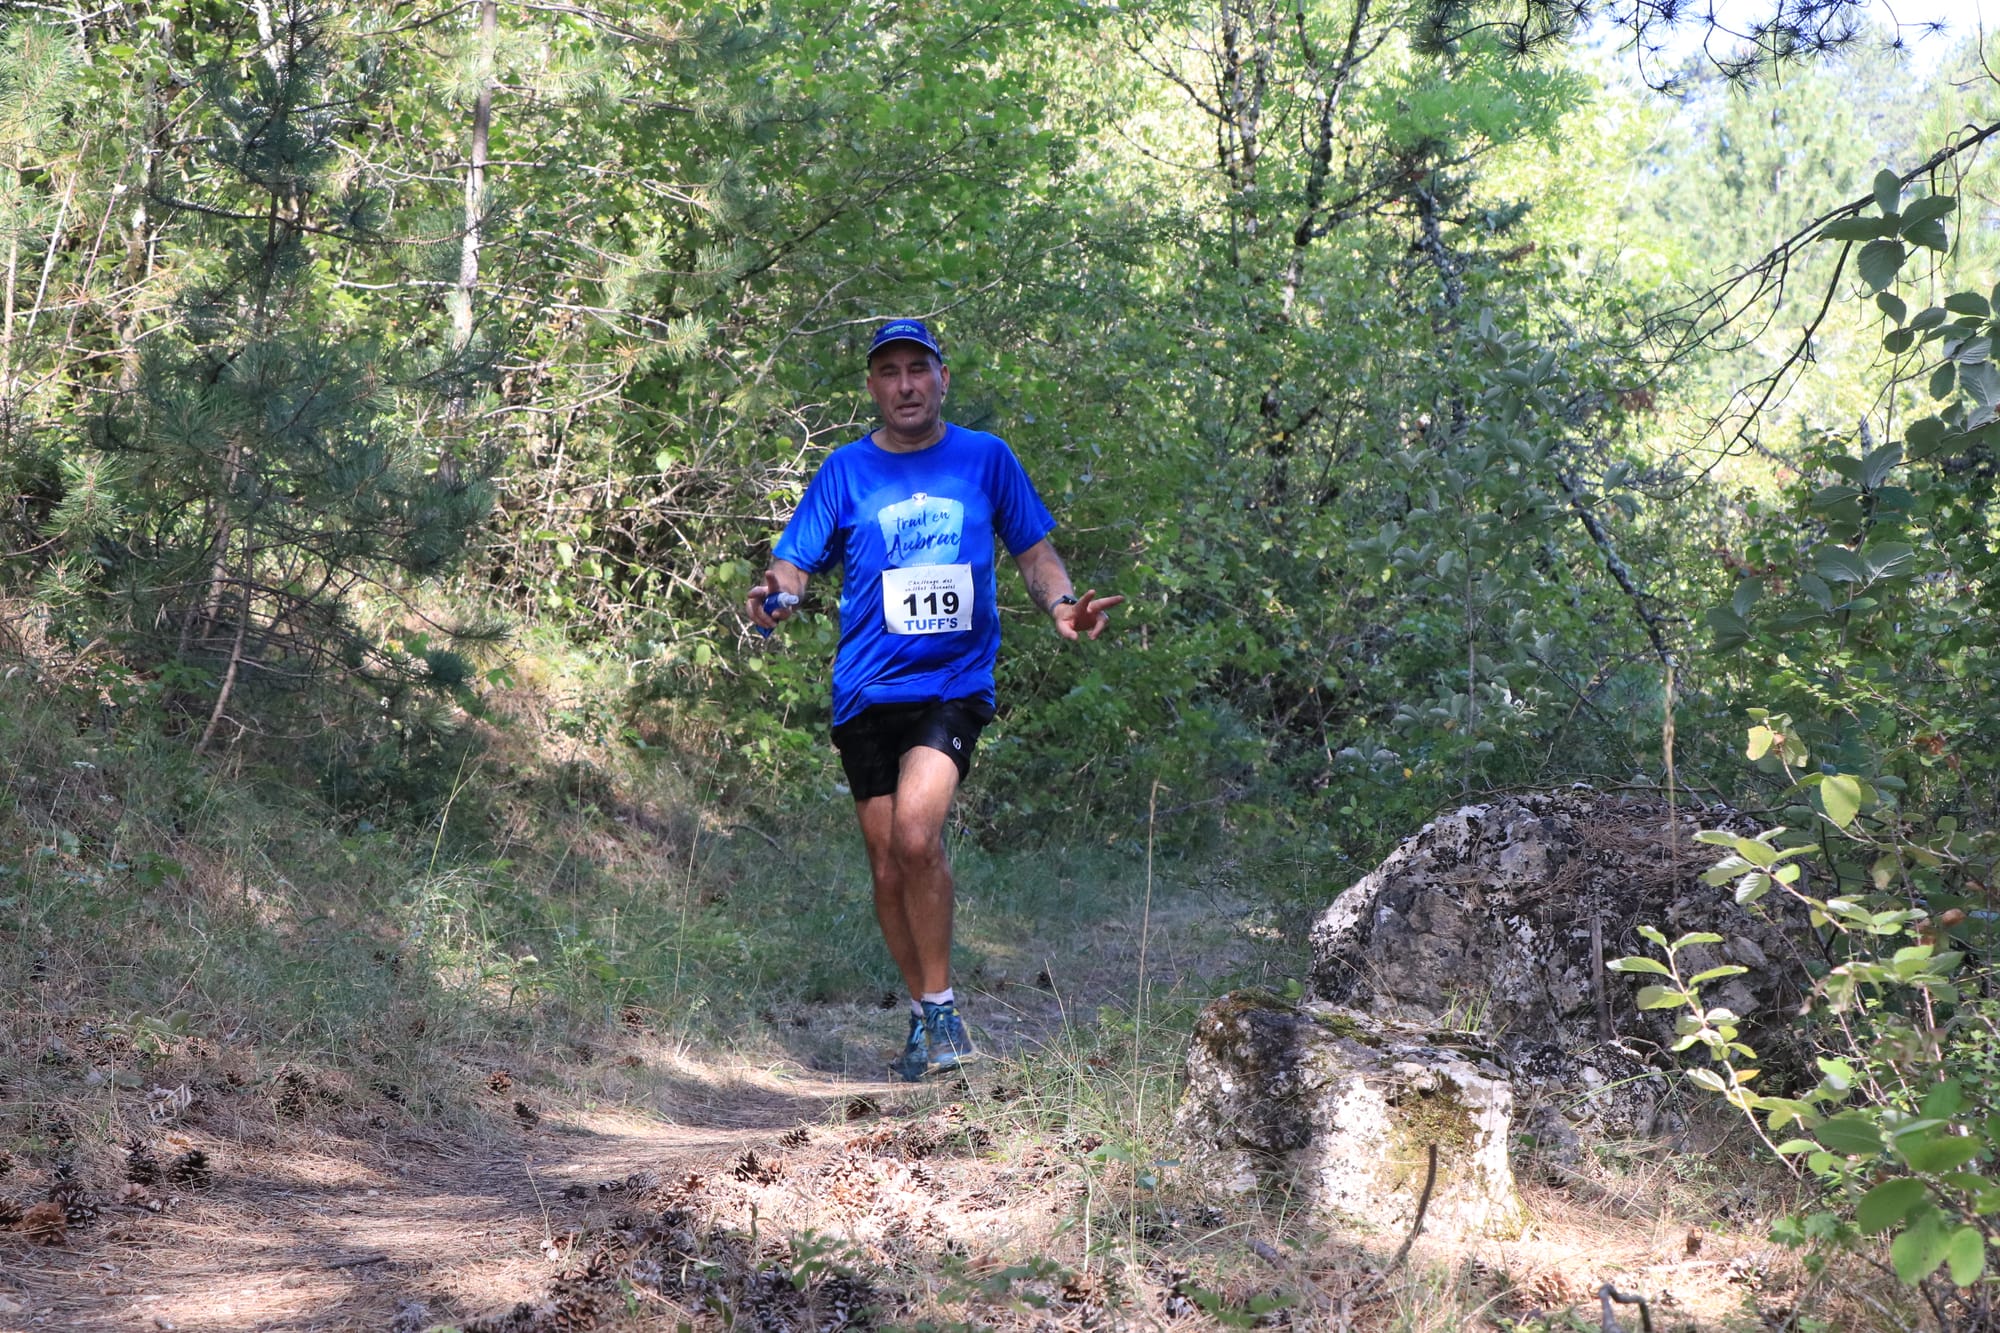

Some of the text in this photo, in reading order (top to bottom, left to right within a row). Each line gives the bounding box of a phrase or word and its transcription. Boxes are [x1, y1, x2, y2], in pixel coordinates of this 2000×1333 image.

[932, 511, 950, 522] en
[886, 531, 961, 560] Aubrac
[903, 591, 960, 617] 119
[904, 617, 958, 631] TUFF'S
